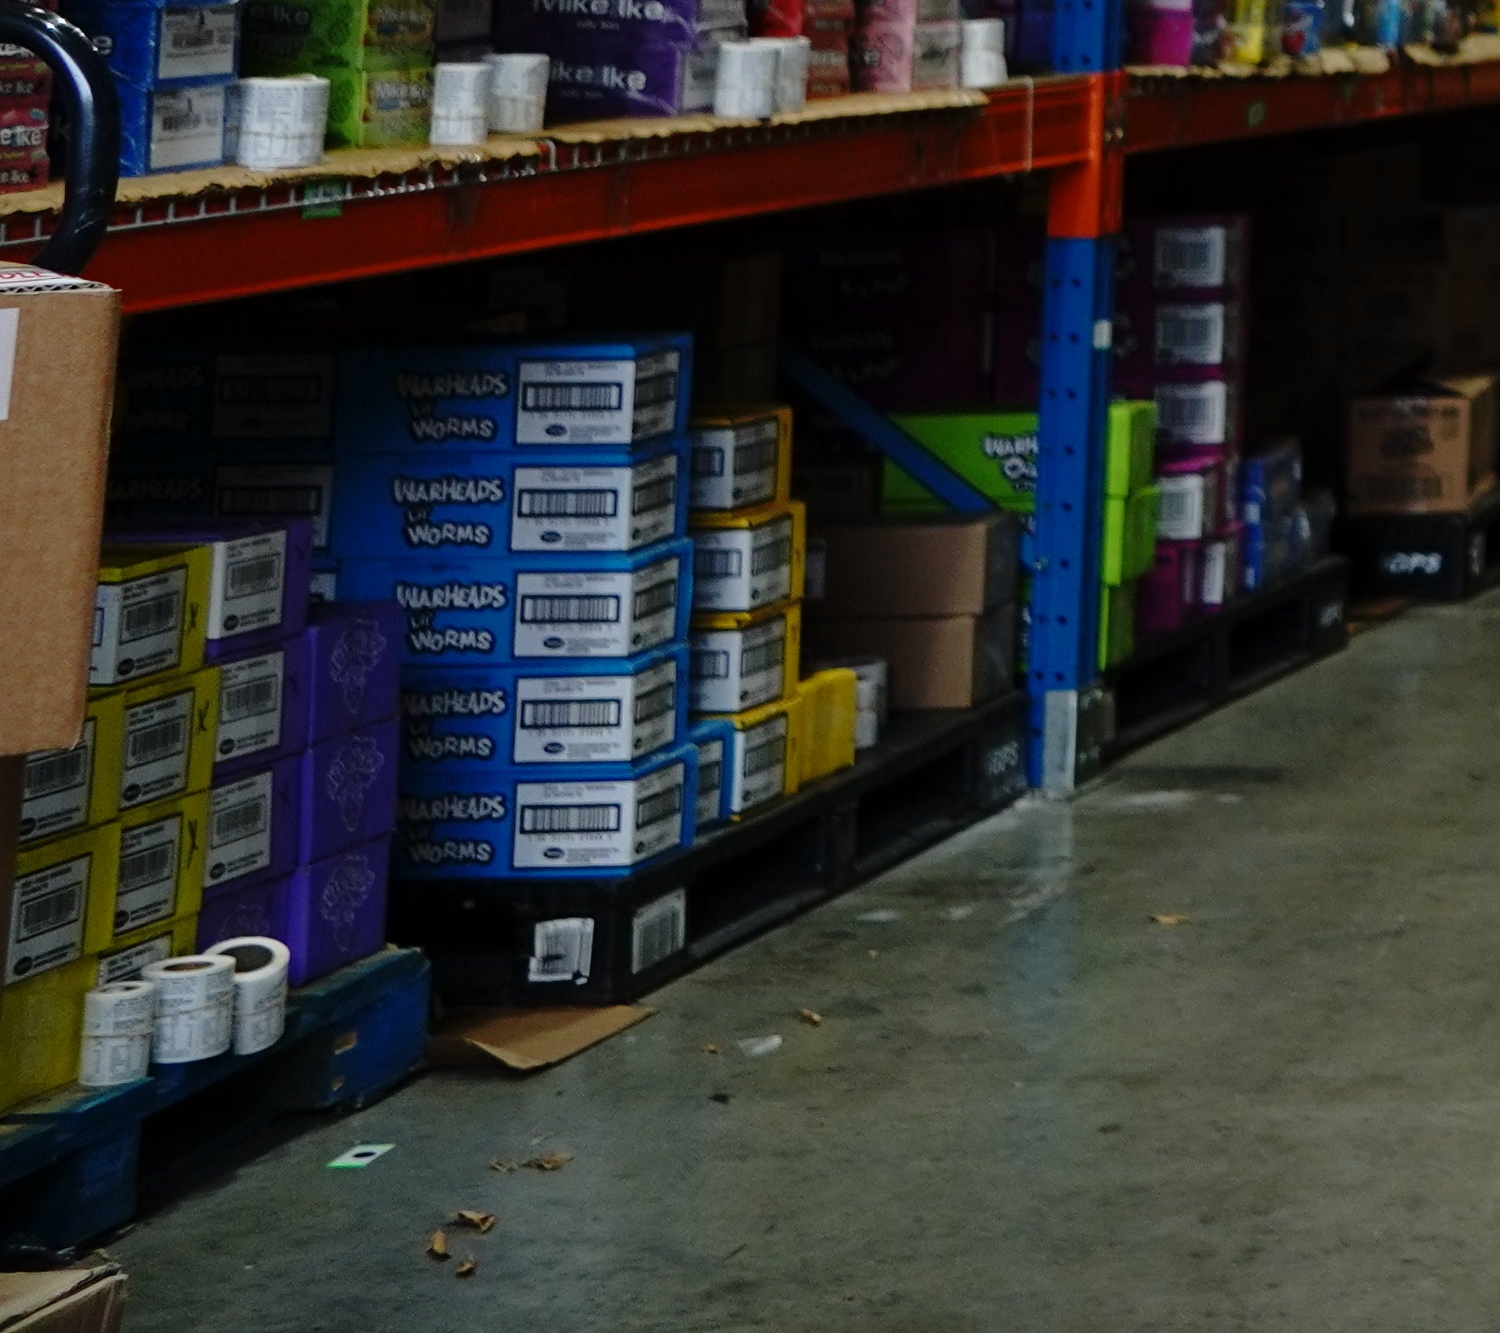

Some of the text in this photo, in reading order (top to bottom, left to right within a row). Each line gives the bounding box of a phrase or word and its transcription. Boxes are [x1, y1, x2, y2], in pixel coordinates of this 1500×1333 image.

[550, 60, 648, 92] ike Ike
[410, 417, 496, 440] WORMS
[393, 478, 505, 506] WARHEADS
[405, 524, 491, 546] WORMS
[396, 583, 506, 610] WARHEADS
[408, 630, 493, 652] WORMS
[408, 736, 494, 760] WORMS
[408, 840, 493, 864] WORMS
